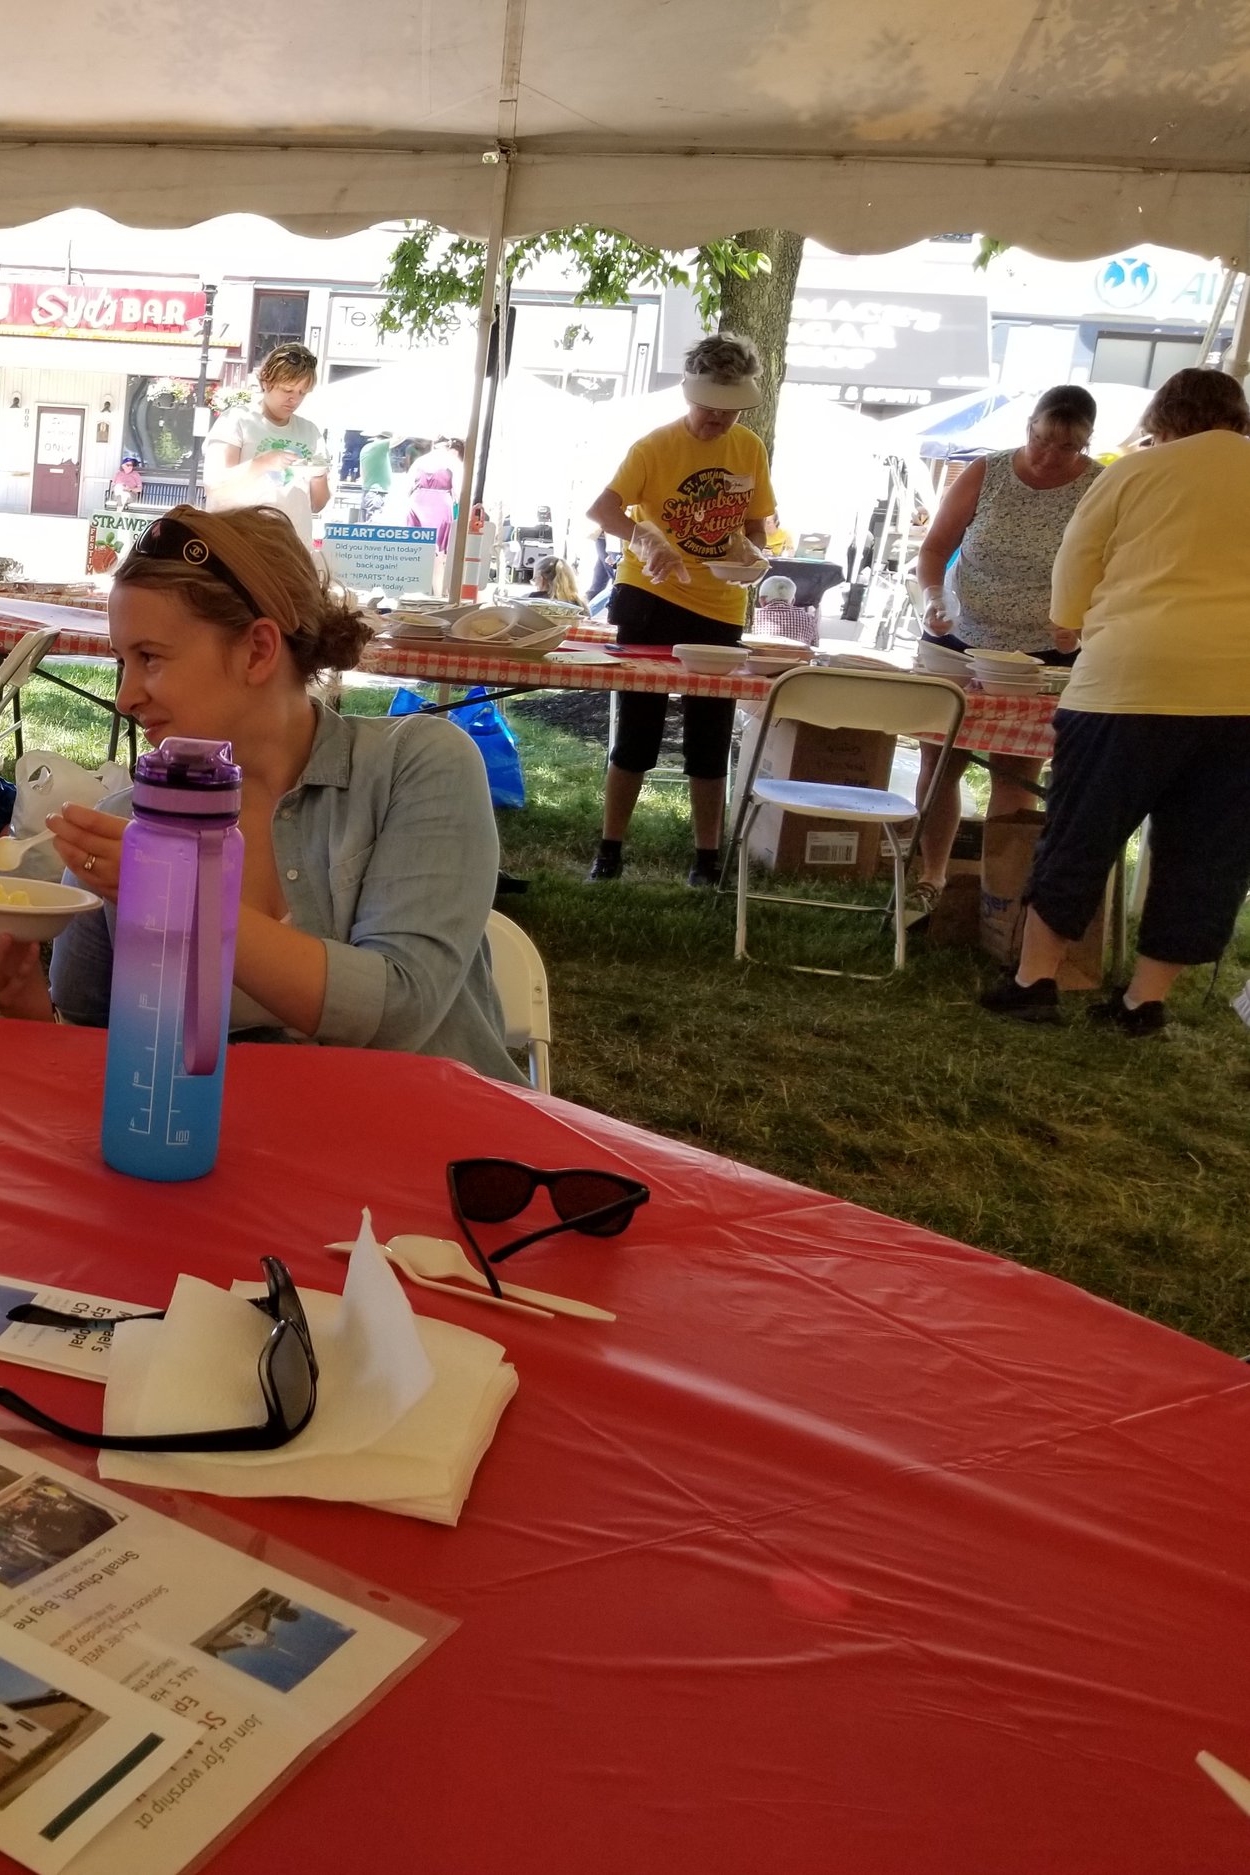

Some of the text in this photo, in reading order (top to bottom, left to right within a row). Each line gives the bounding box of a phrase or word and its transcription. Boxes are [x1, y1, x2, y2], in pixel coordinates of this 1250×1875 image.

[121, 298, 186, 325] BAR
[698, 471, 724, 482] MICHA
[92, 514, 152, 532] STRAWB
[326, 526, 435, 541] THE ART GOES ON!
[397, 546, 422, 554] today?
[684, 540, 717, 555] EPISCOPAL
[364, 553, 383, 562] bring
[375, 562, 398, 570] again!
[102, 1550, 140, 1577] Small
[30, 1599, 61, 1618] Big
[13, 1616, 39, 1631] he
[150, 1687, 172, 1702] Ha
[135, 1713, 263, 1830] Join us for worship at
